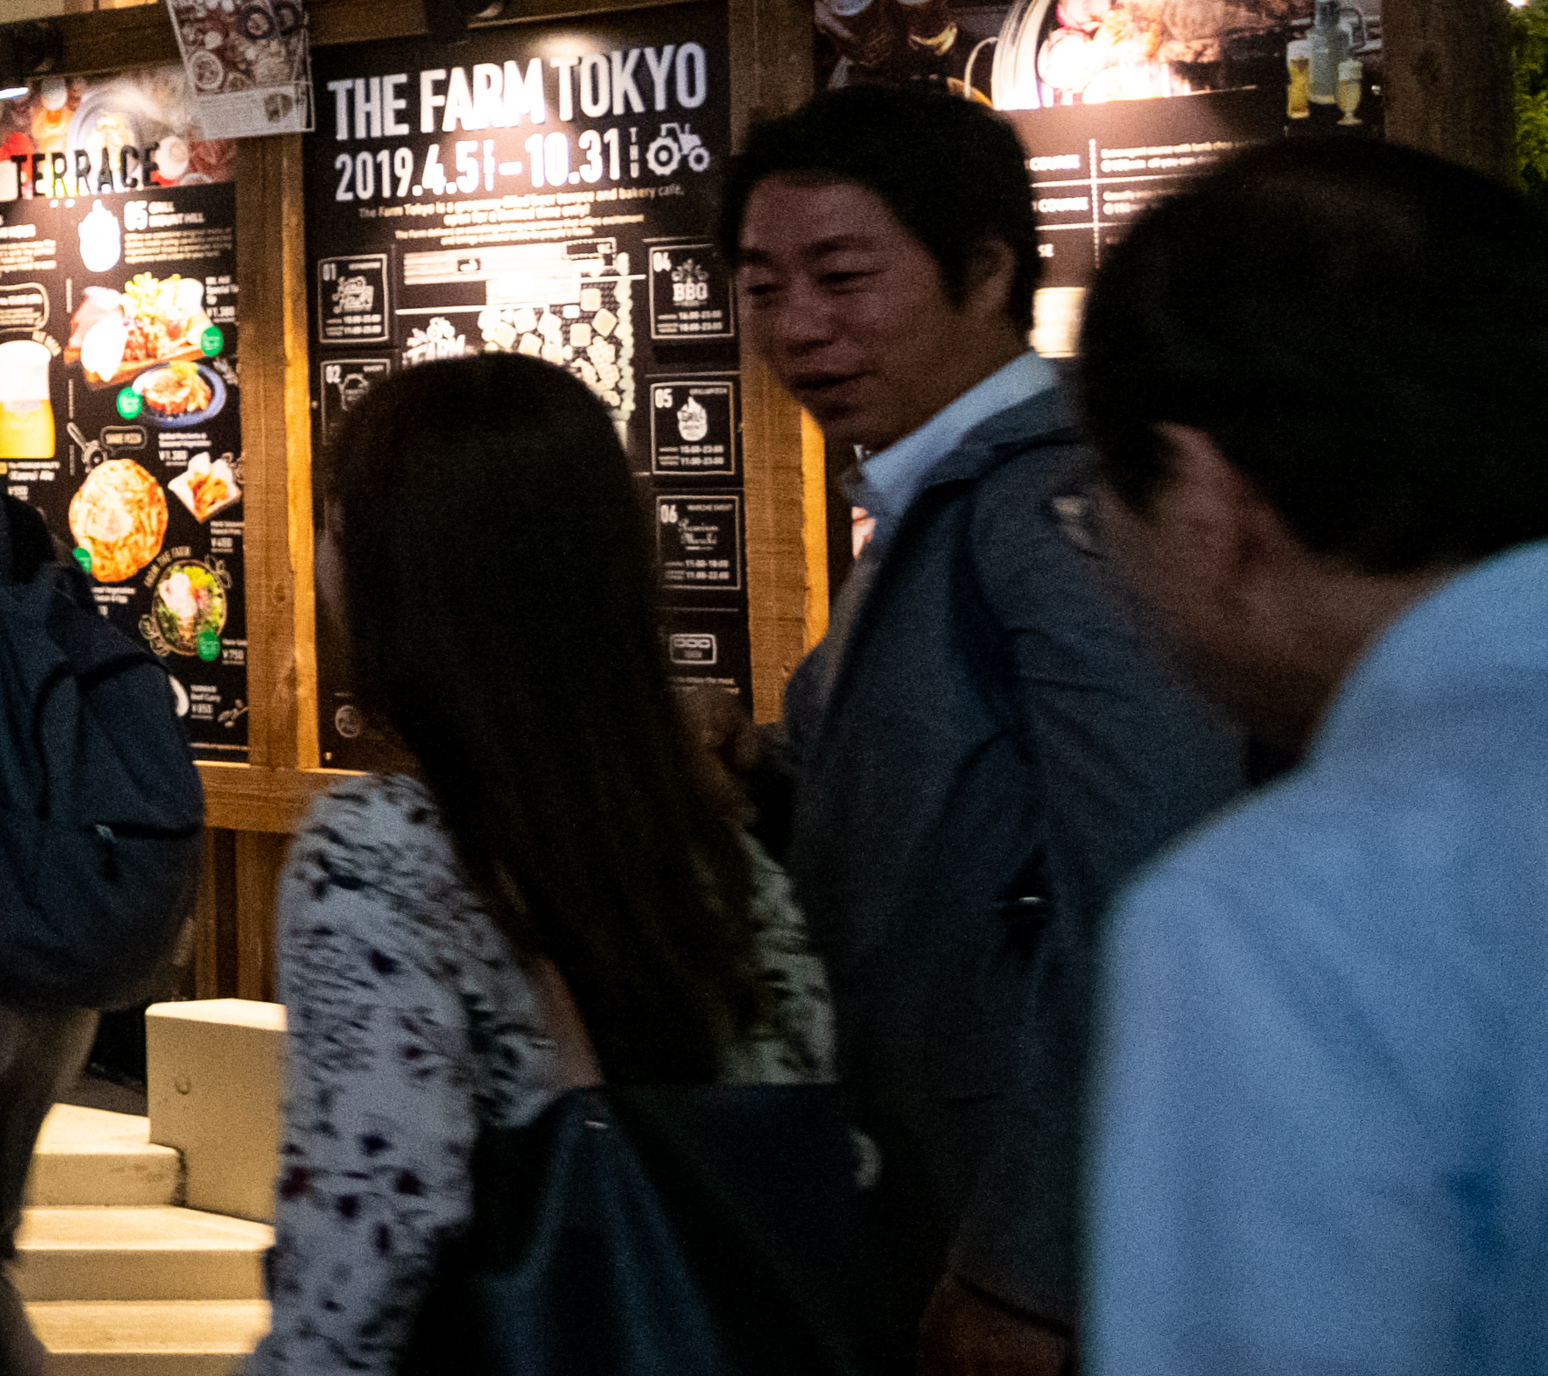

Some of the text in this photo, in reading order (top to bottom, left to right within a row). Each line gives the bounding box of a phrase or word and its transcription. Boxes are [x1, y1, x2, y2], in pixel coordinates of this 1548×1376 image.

[327, 41, 707, 141] THE FARM TOKYO
[11, 141, 162, 199] TERRACE
[334, 138, 480, 202] 2019.4.5
[524, 128, 621, 189] 10.31
[1029, 154, 1081, 172] COURSE
[404, 202, 435, 219] Tokyo
[1037, 196, 1089, 213] COURSE
[123, 200, 148, 231] 05
[653, 251, 672, 273] 04
[672, 283, 708, 302] BBQ
[655, 388, 673, 409] 05
[660, 504, 678, 524] 06
